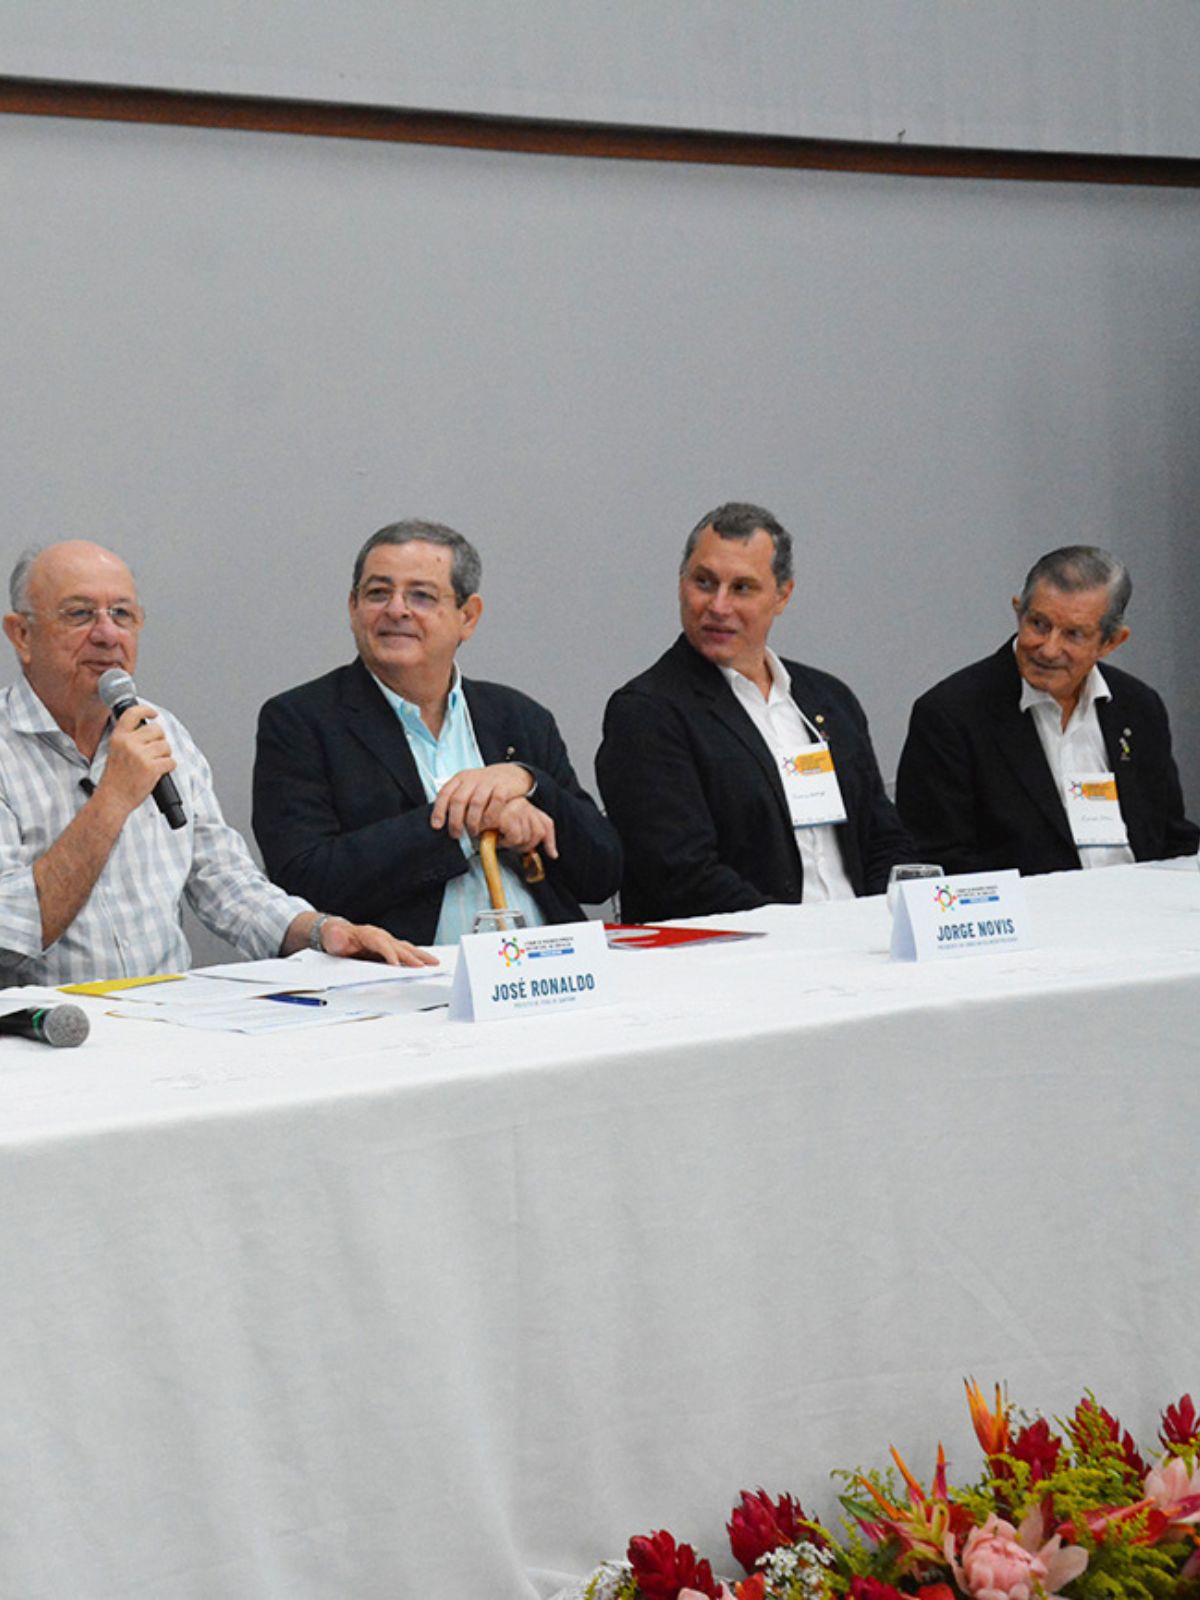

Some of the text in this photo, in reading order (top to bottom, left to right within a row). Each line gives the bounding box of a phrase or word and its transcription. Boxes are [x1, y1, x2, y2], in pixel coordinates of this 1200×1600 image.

[936, 917, 1016, 942] JORGE NOVIS
[492, 977, 527, 1002] JOSÉ
[531, 973, 596, 997] RONALDO
